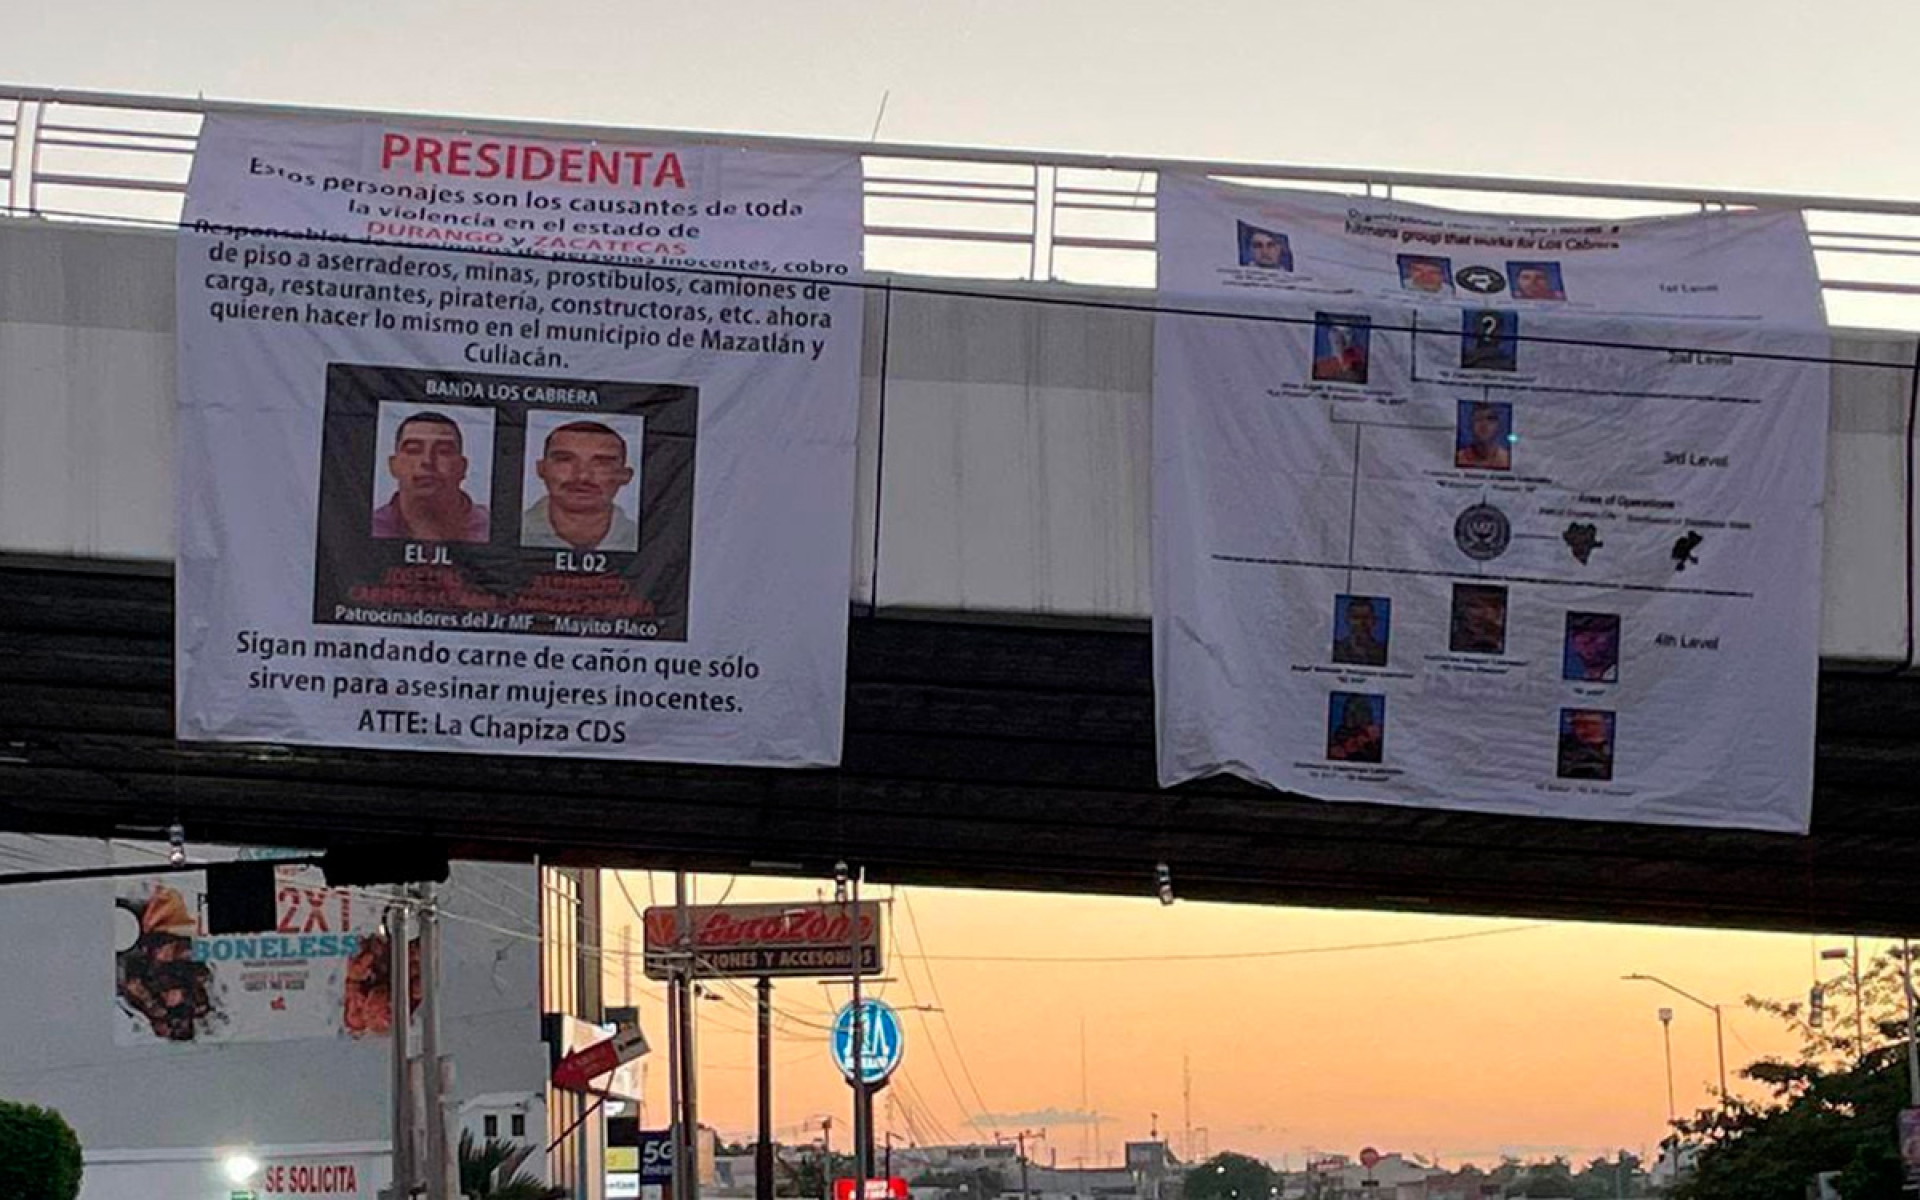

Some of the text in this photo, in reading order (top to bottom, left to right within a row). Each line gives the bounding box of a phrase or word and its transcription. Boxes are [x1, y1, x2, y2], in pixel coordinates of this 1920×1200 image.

[381, 132, 686, 189] PRESIDENTA
[250, 157, 803, 218] Estos personajes son los causantes de toda
[349, 200, 700, 239] la violencia en el estado de
[367, 221, 504, 244] DURANGO
[512, 236, 526, 247] y
[534, 235, 687, 255] ZACATECAS
[208, 241, 831, 301] de piso a aserraderos, minas, prostíbulos, camiones de
[784, 260, 848, 276] cobro
[205, 272, 832, 329] carga, restaurantes, piratería, constructoras, etc. ahora
[210, 299, 824, 360] quieren hacer lo mismo en el municipio de Mazatlán y
[464, 342, 569, 368] Culiacán.
[426, 379, 598, 405] BANDA LOS CABRERA
[1663, 451, 1728, 467] 3rd Level
[404, 544, 452, 566] EL JL
[555, 552, 607, 572] EL 02
[335, 604, 458, 625] Patrocinadores
[462, 612, 488, 628] del
[490, 613, 506, 628] Jr
[508, 614, 533, 630] MF
[237, 630, 760, 680] Sigan mandando carne de cañón que sólo
[1681, 633, 1719, 650] Level
[249, 667, 743, 713] sirven para asesinar mujeres inocentes.
[358, 709, 626, 744] ATTE: La Chapiza CDS
[192, 935, 359, 963] BONELESS
[765, 952, 775, 966] Y
[779, 949, 872, 967] ACCESORIS
[266, 1165, 357, 1193] SE SOLICITA
